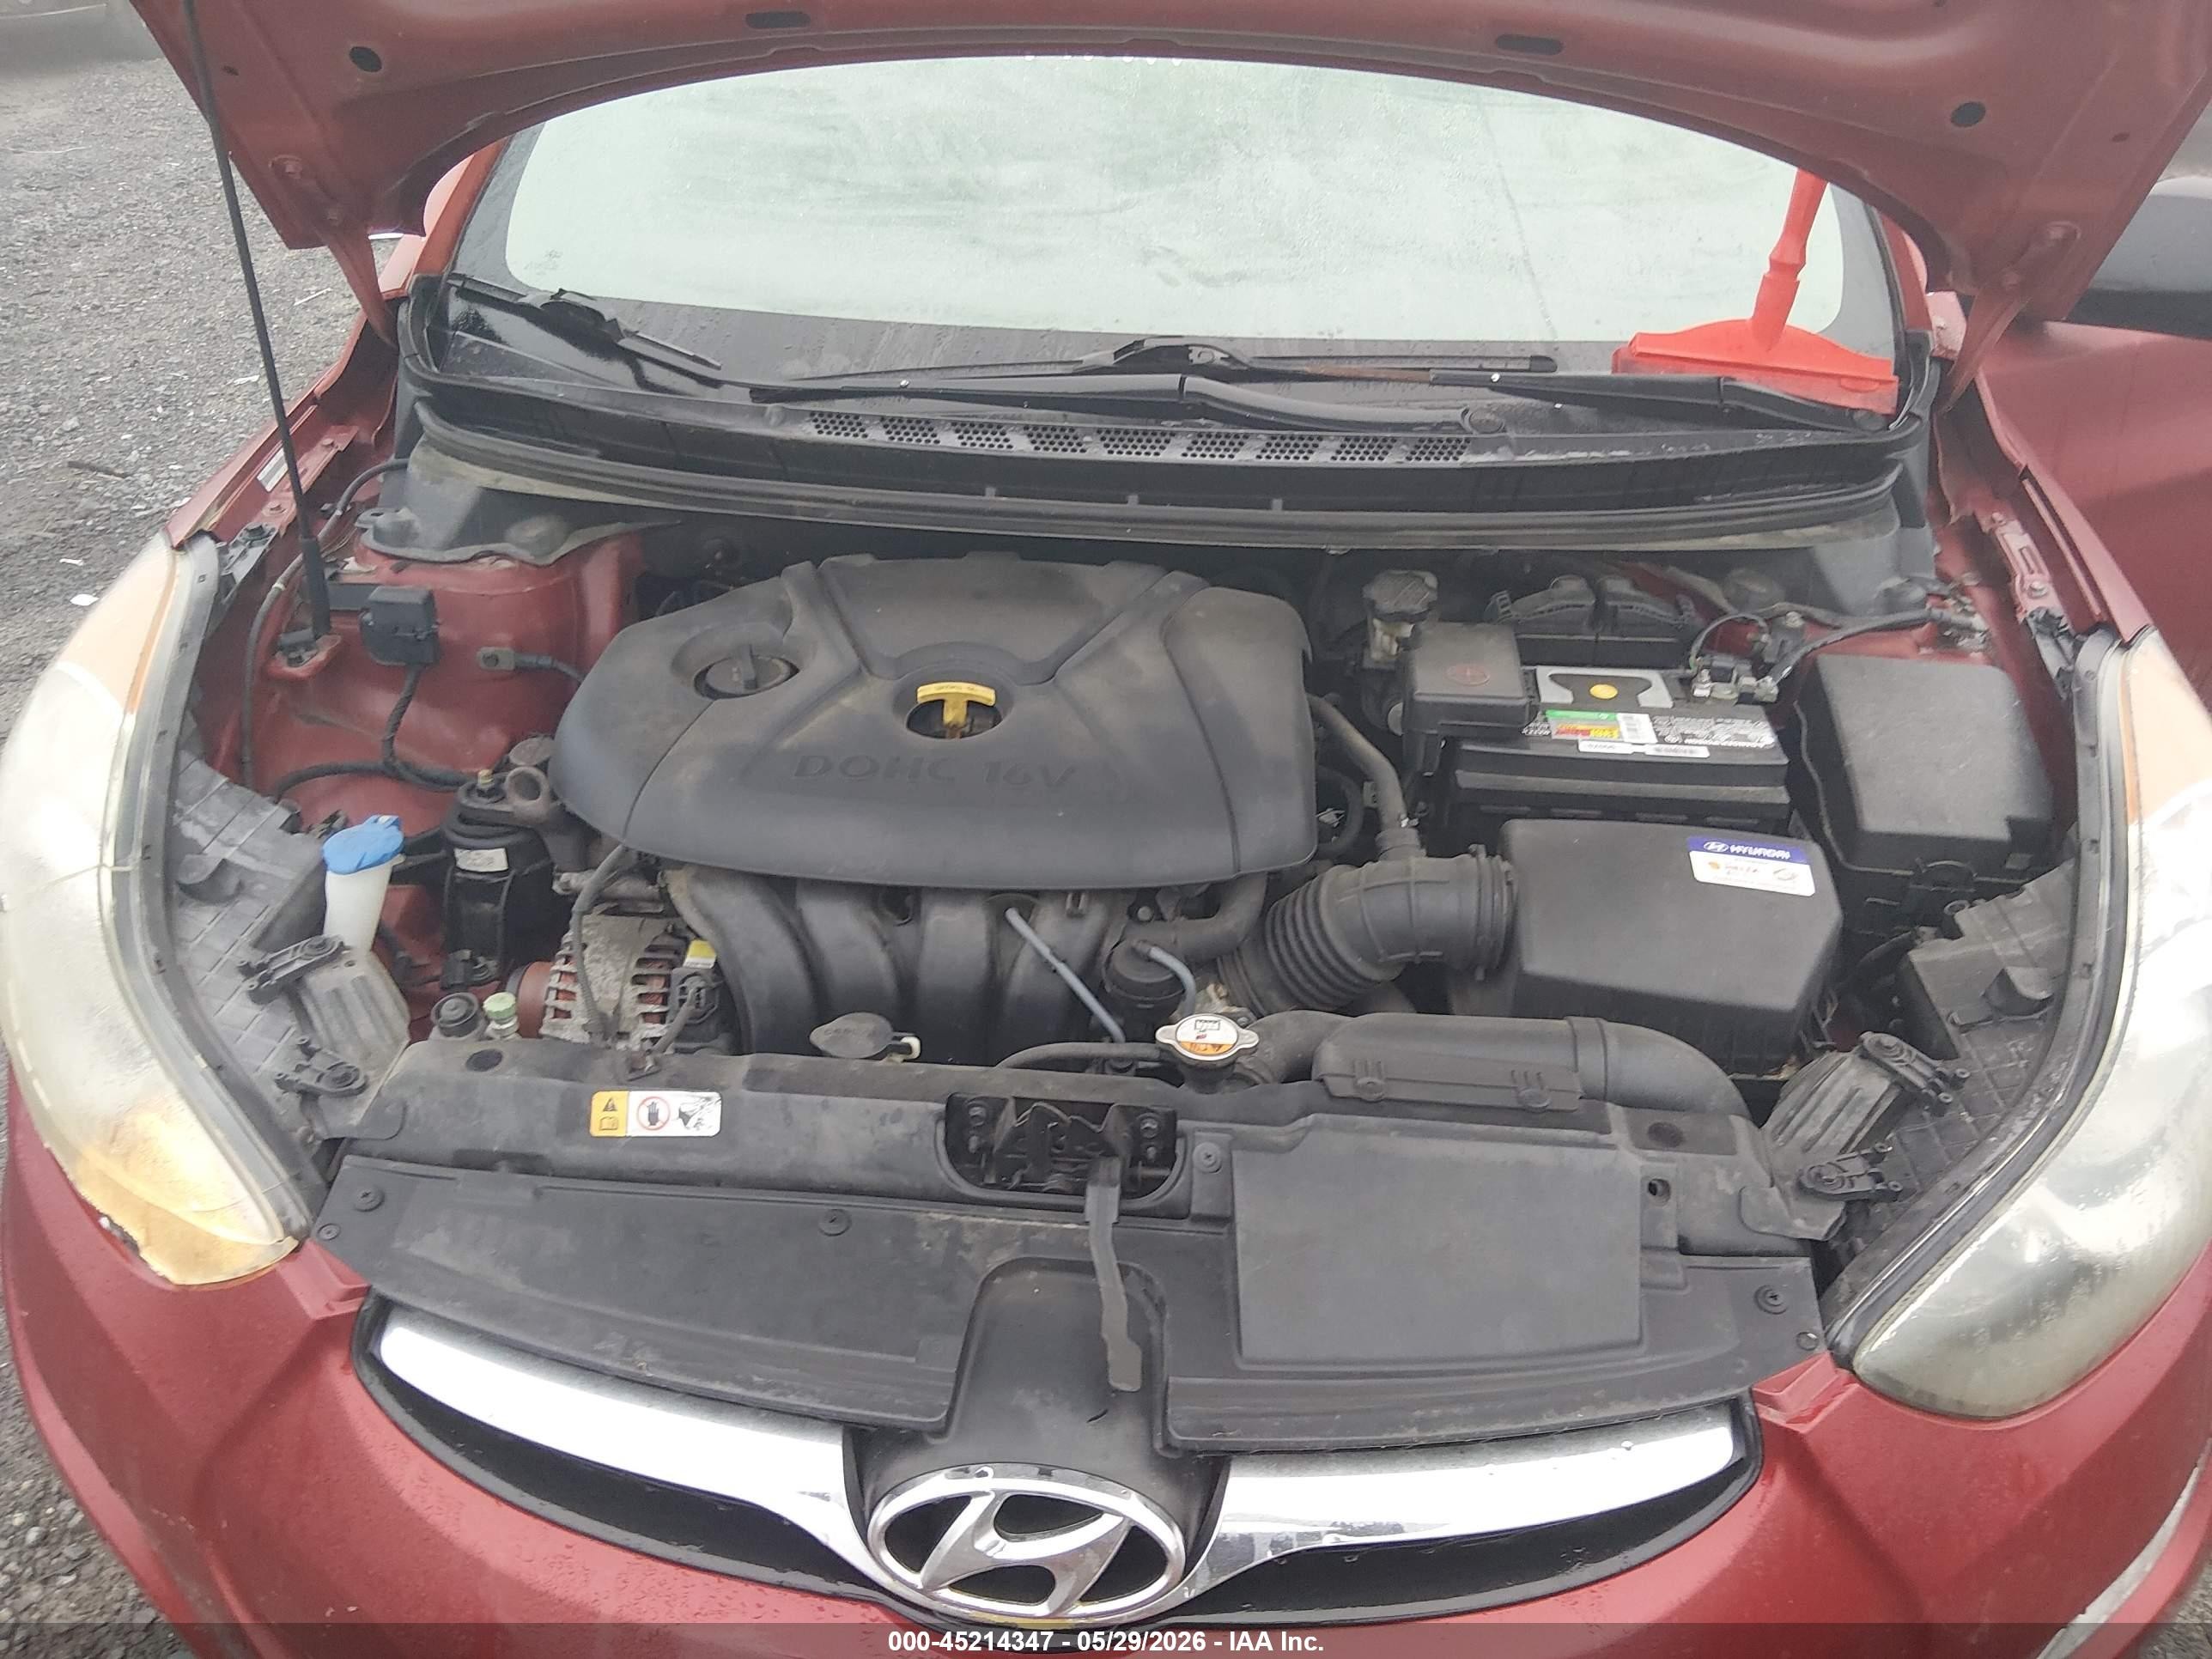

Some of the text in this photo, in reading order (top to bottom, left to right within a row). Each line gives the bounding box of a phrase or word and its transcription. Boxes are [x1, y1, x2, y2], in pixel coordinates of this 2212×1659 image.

[793, 754, 1079, 789] DOHC 16V
[1730, 845, 1790, 860] HYUNDAI
